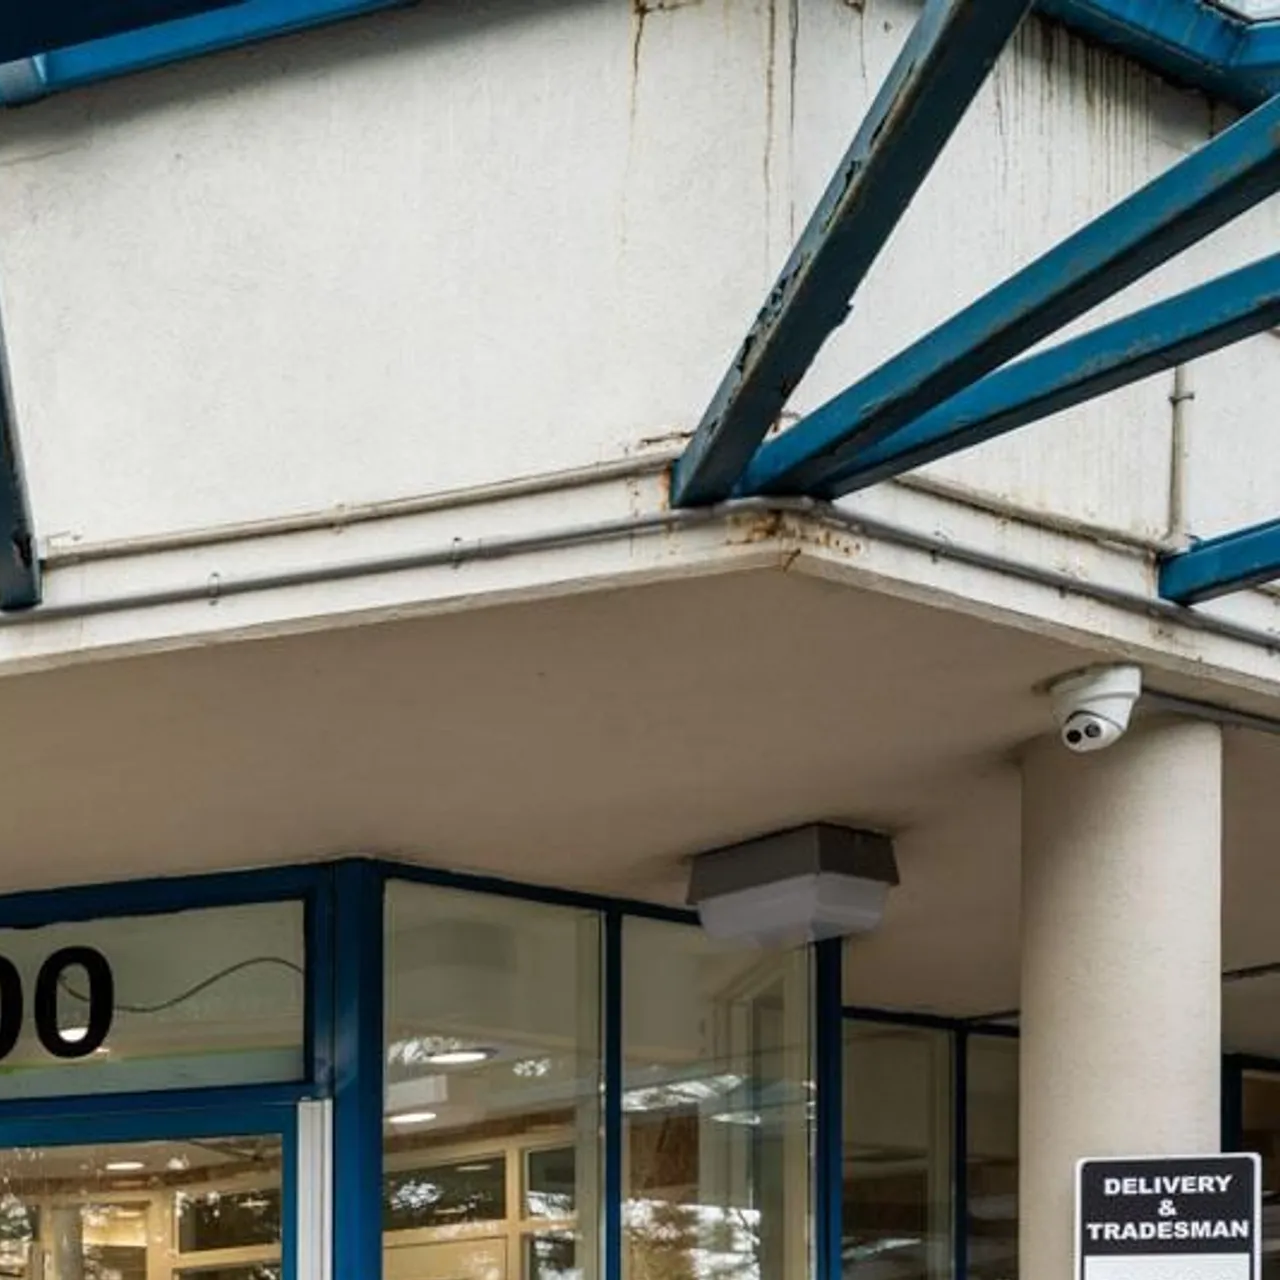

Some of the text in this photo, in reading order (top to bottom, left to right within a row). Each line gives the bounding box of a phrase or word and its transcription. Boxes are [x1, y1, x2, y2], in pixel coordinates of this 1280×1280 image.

[1103, 1174, 1233, 1195] DELIVERY
[1157, 1199, 1177, 1217] &
[1086, 1219, 1250, 1241] TRADESMAN
